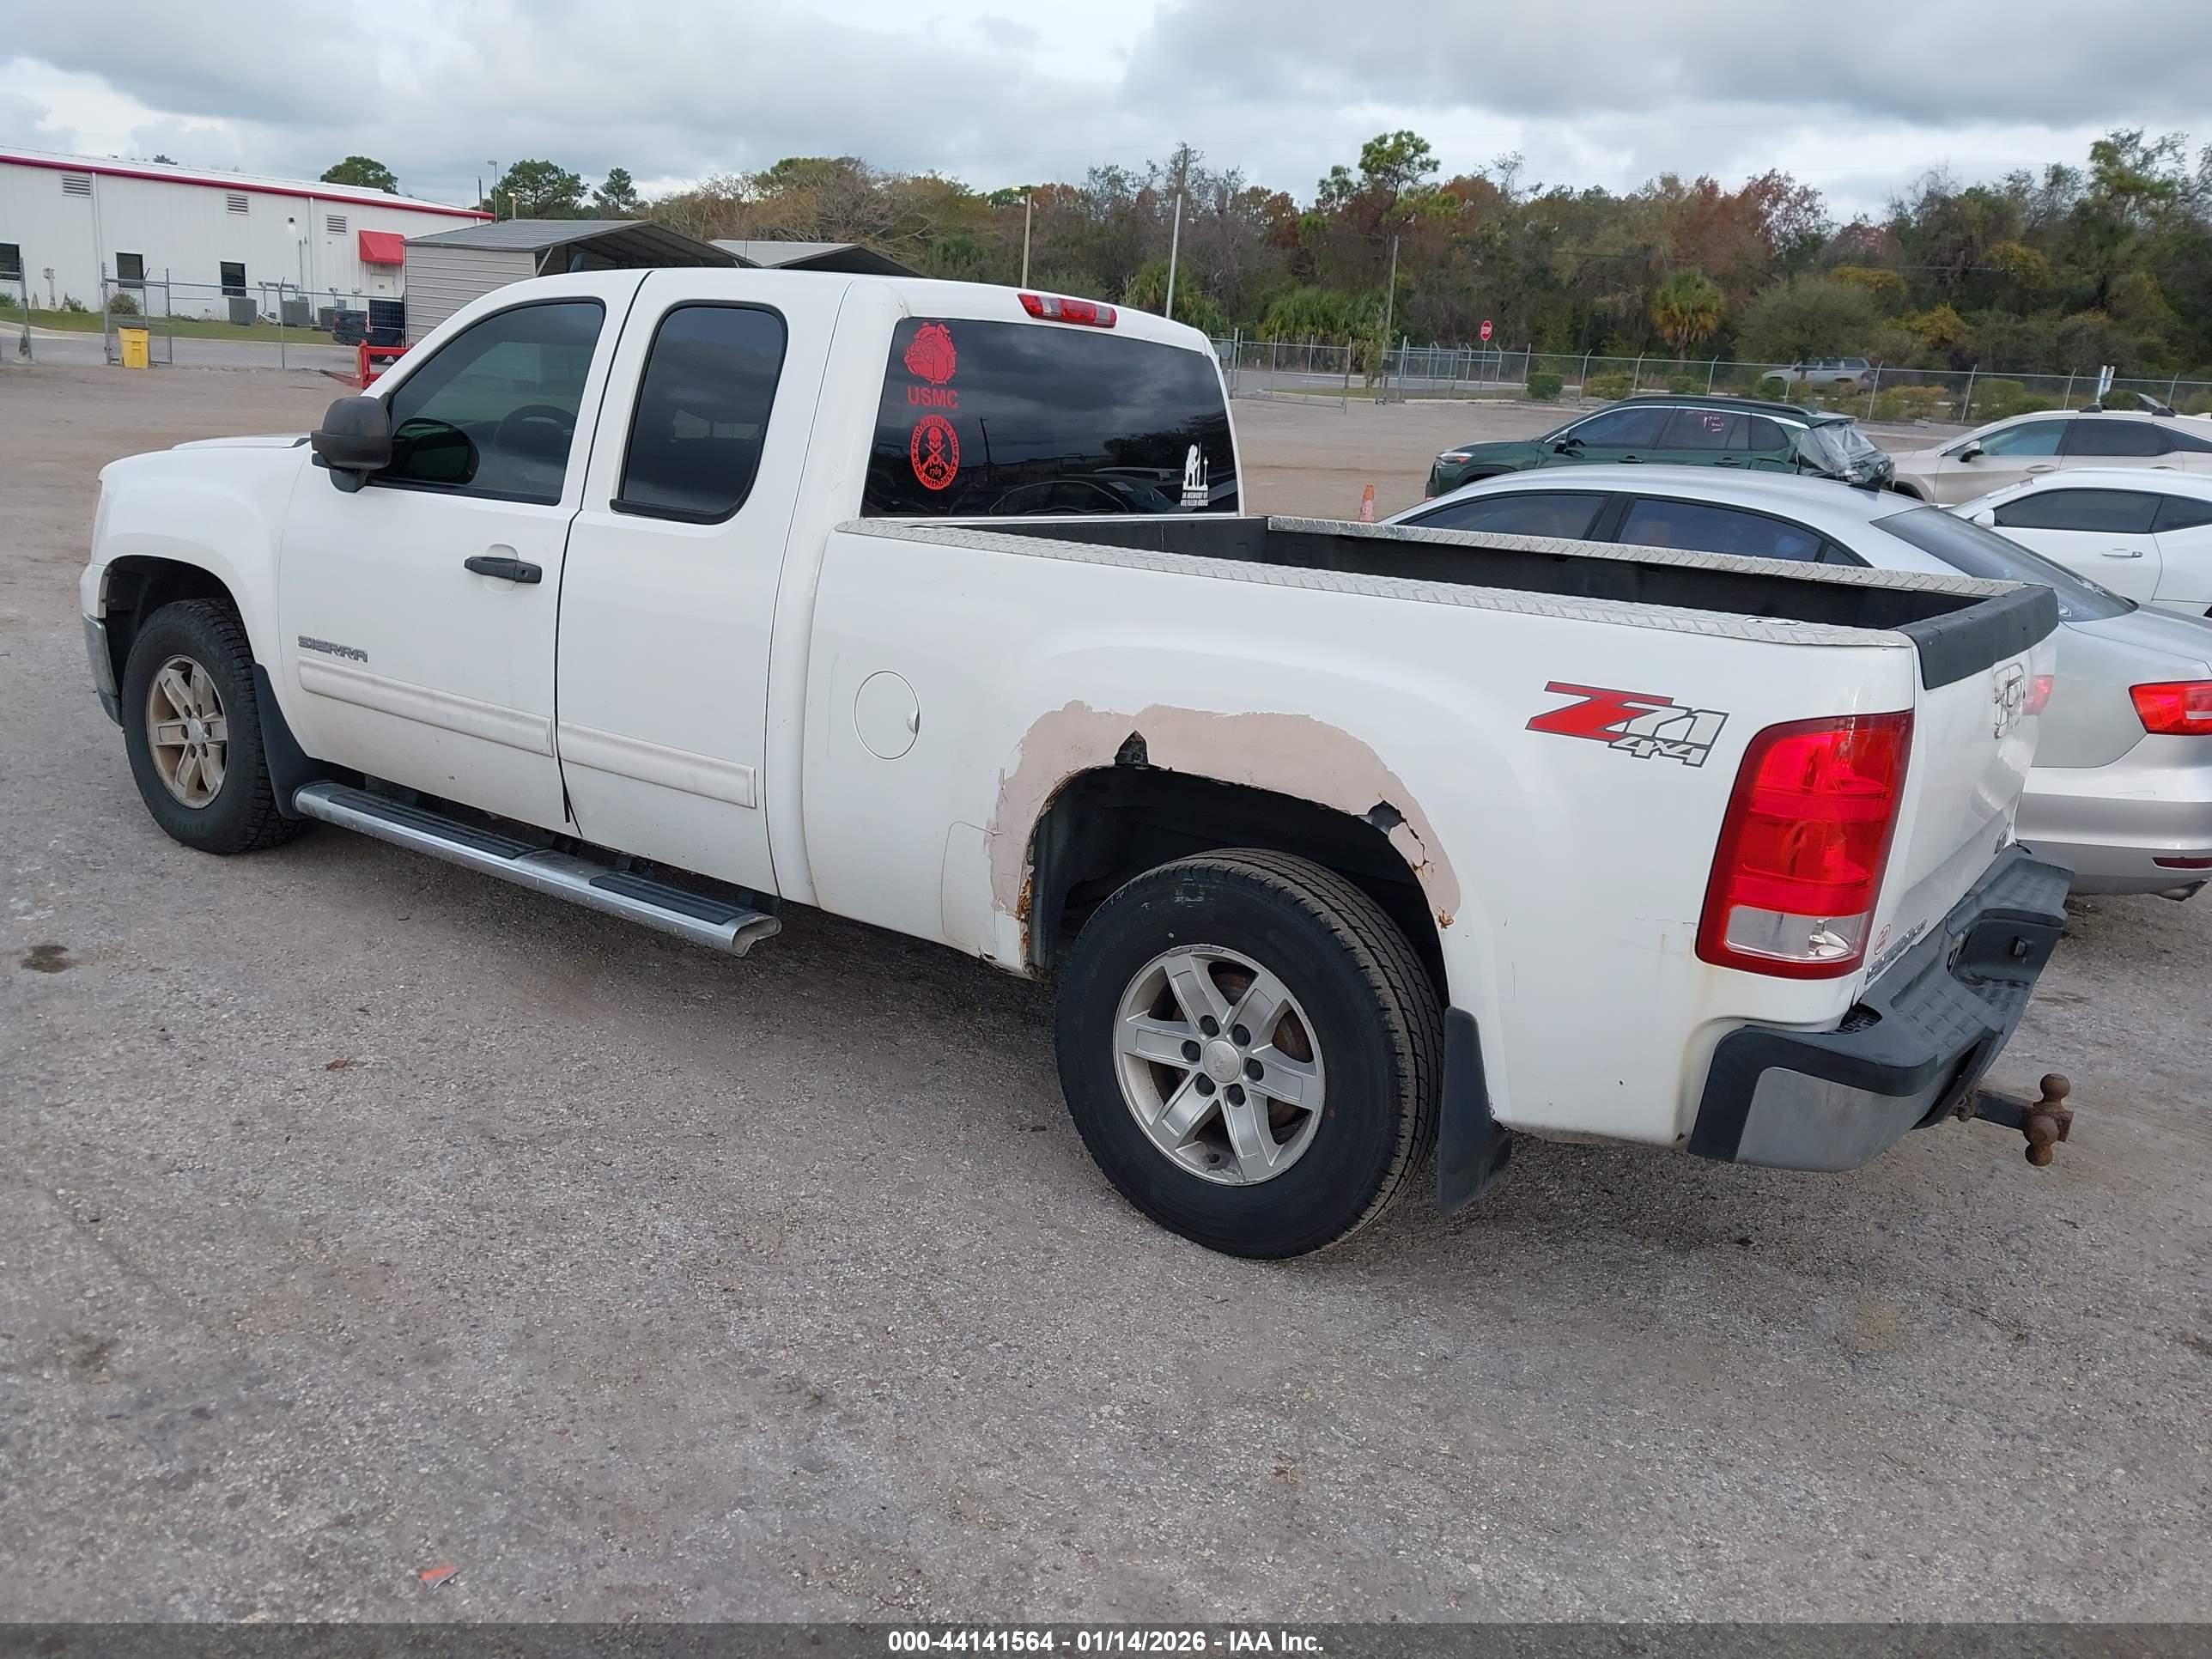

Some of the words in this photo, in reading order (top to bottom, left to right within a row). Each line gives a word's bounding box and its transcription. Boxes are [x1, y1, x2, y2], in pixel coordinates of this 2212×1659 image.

[907, 386, 959, 409] USMC
[298, 635, 368, 663] SIERRA
[1525, 681, 1730, 749] Z71
